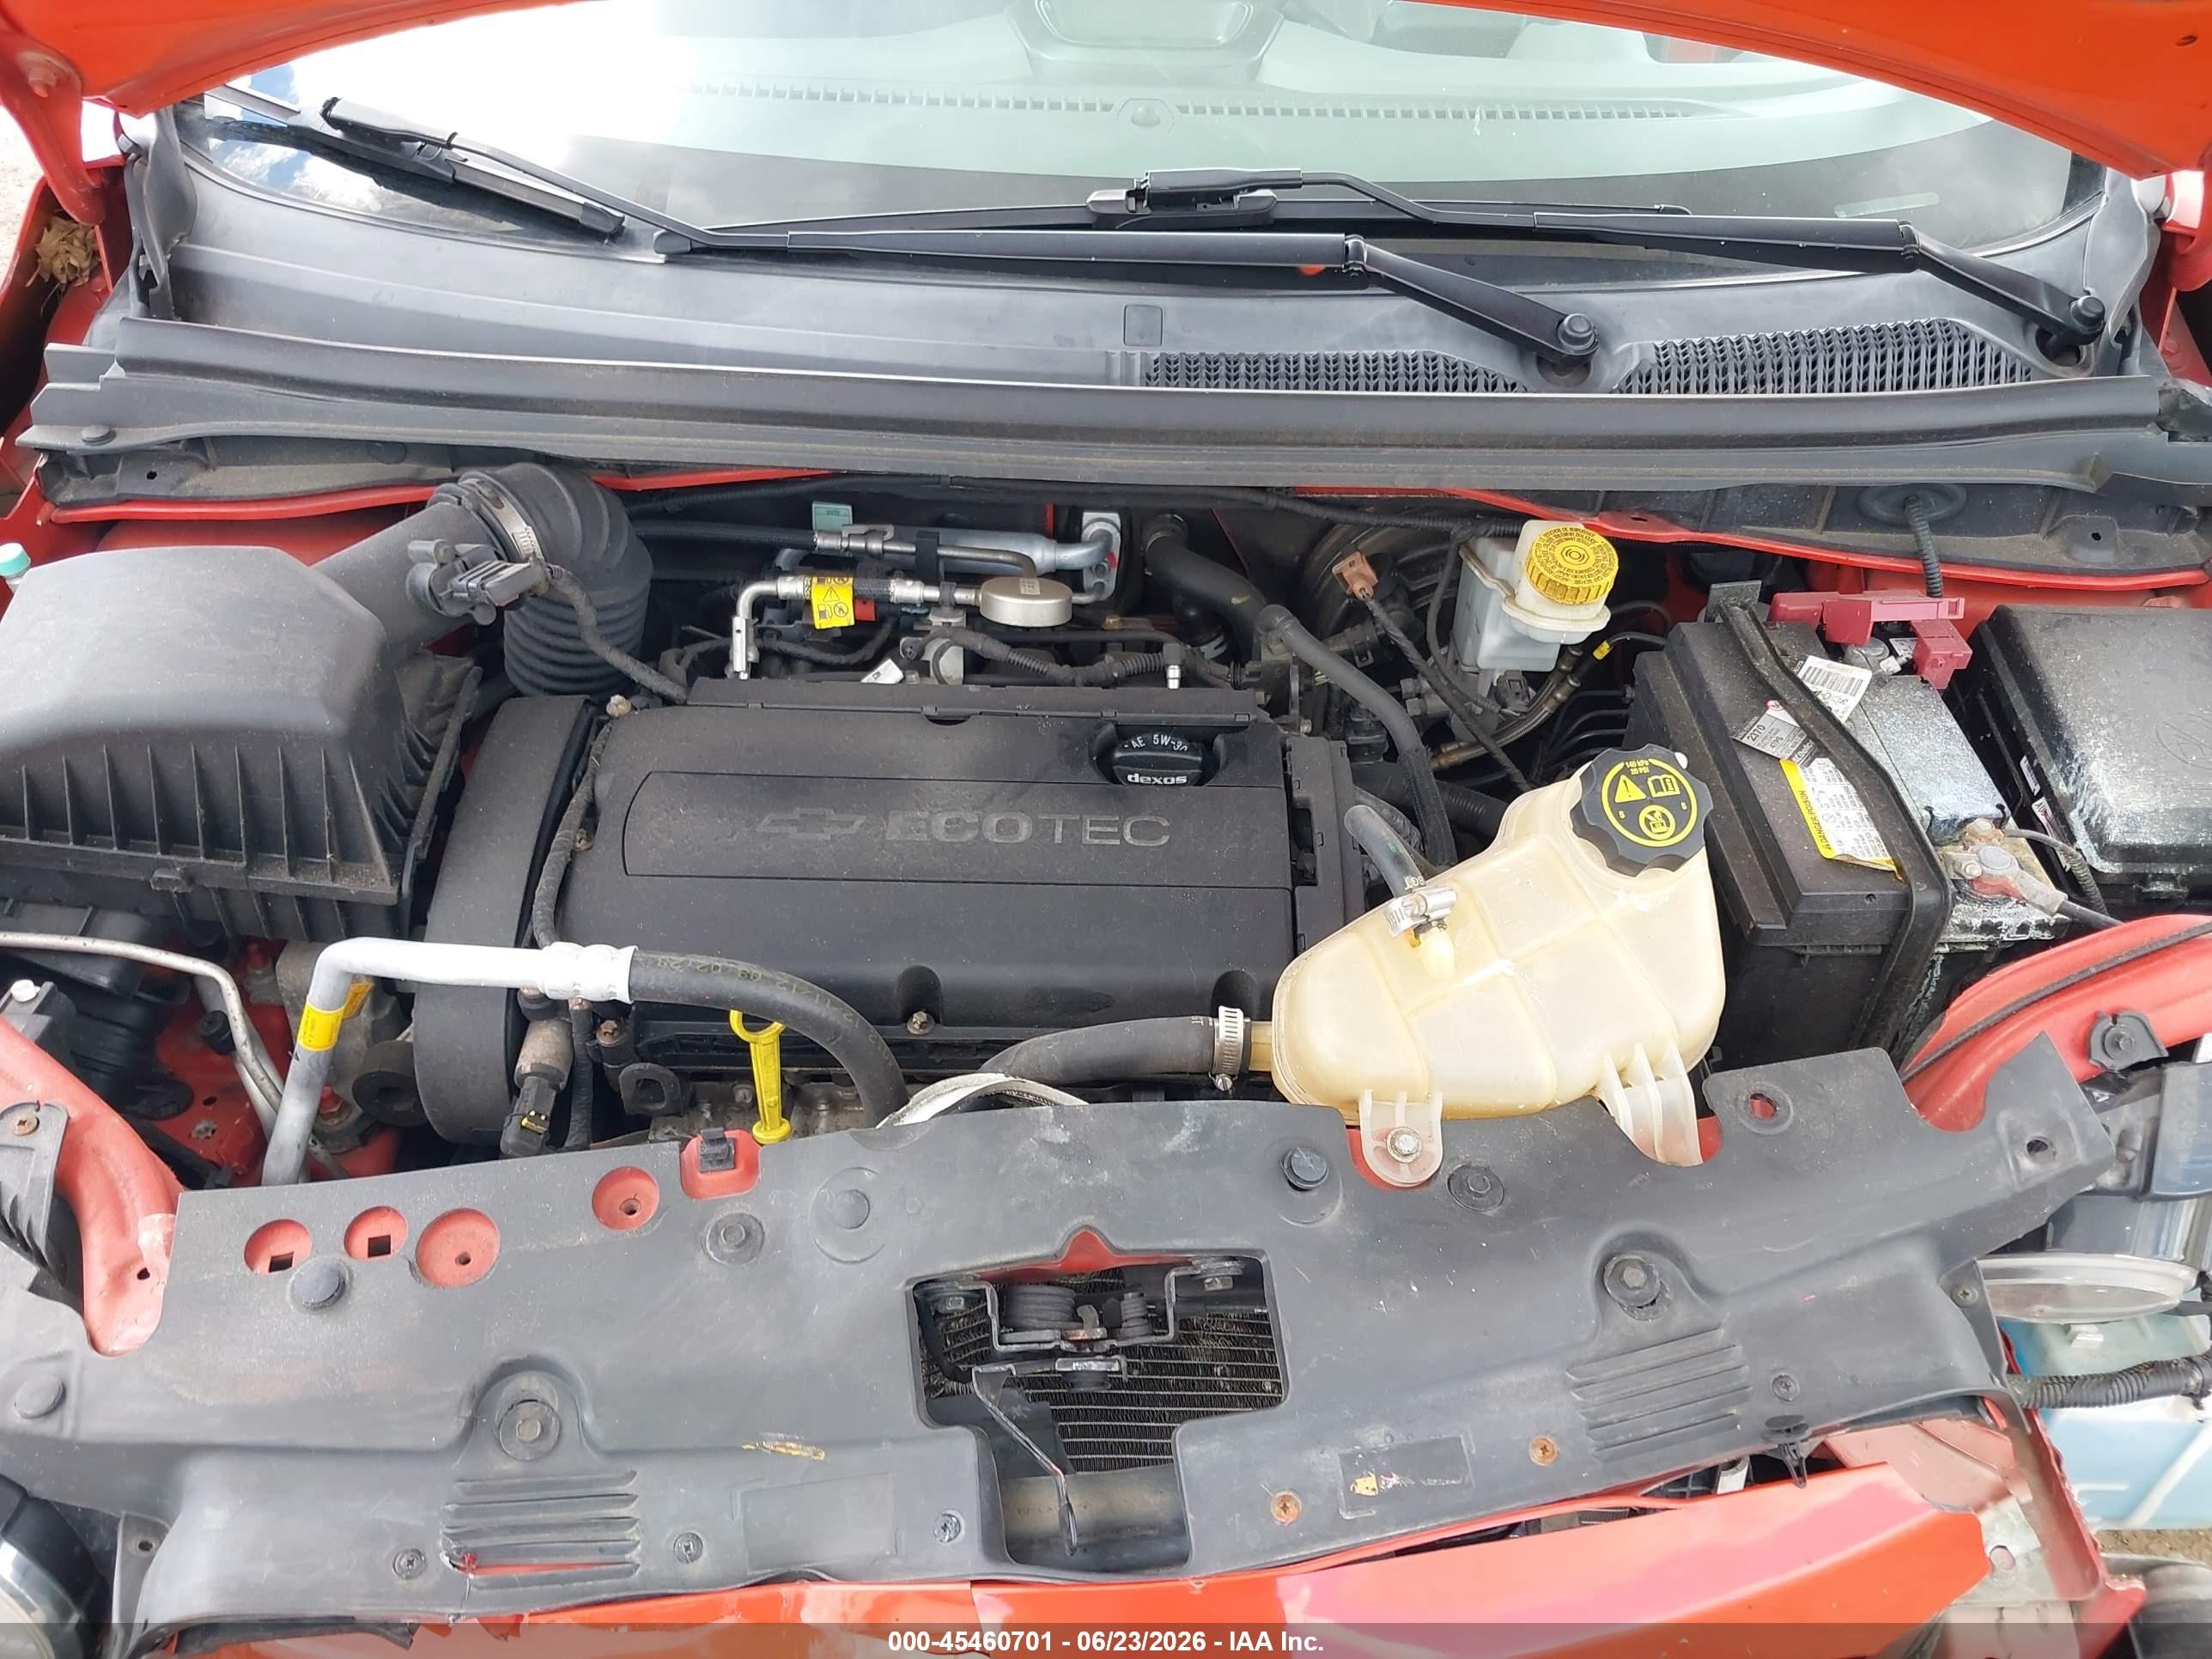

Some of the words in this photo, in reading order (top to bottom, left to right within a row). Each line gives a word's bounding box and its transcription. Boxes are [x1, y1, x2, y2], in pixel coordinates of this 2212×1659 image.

[1123, 735, 1146, 749] AE
[1127, 773, 1188, 785] dexos
[1798, 789, 1816, 817] POISON
[885, 810, 1170, 847] ECOTEC
[1810, 816, 1828, 845] DANGER
